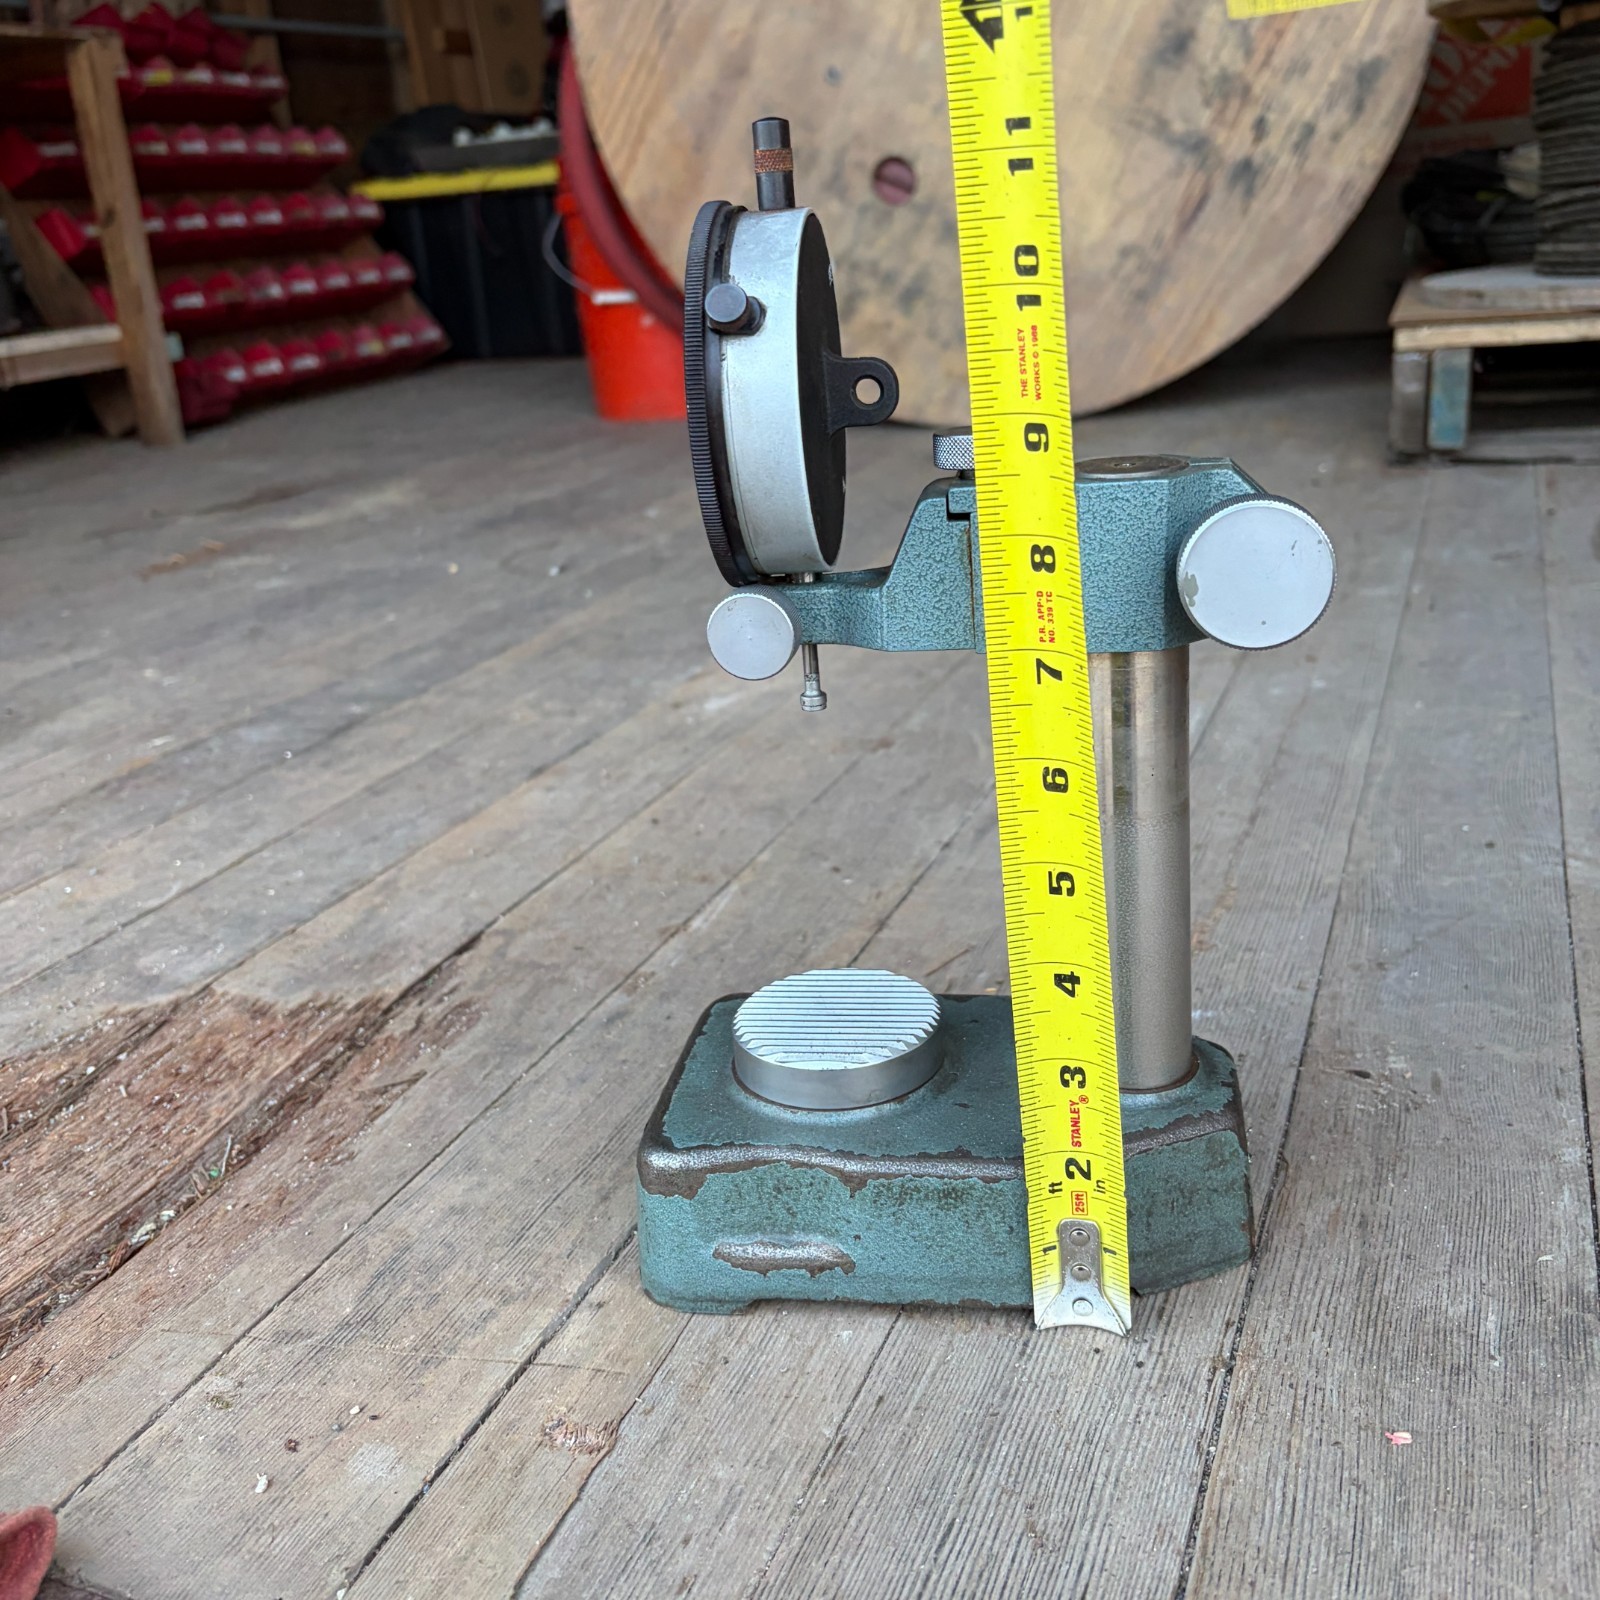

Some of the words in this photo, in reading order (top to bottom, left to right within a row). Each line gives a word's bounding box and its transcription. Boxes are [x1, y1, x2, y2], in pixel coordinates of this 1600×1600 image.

[1014, 244, 1042, 311] 10
[1017, 328, 1027, 375] STANLEY
[1020, 378, 1028, 398] THE
[1033, 361, 1042, 400] WORKS
[1024, 422, 1049, 453] 9
[1030, 544, 1056, 574] 8
[1046, 591, 1052, 602] TC
[1046, 606, 1054, 624] 339
[1036, 658, 1063, 685] 7
[1042, 766, 1069, 794] 6
[1048, 870, 1075, 897] 5
[1053, 970, 1081, 998] 4
[1060, 1065, 1086, 1089] 3
[1065, 1157, 1092, 1181] 2
[1048, 1181, 1063, 1194] ft
[1093, 1180, 1106, 1194] in
[1074, 1193, 1085, 1213] 25ft
[1042, 1245, 1057, 1255] 1
[1102, 1246, 1118, 1256] 1
